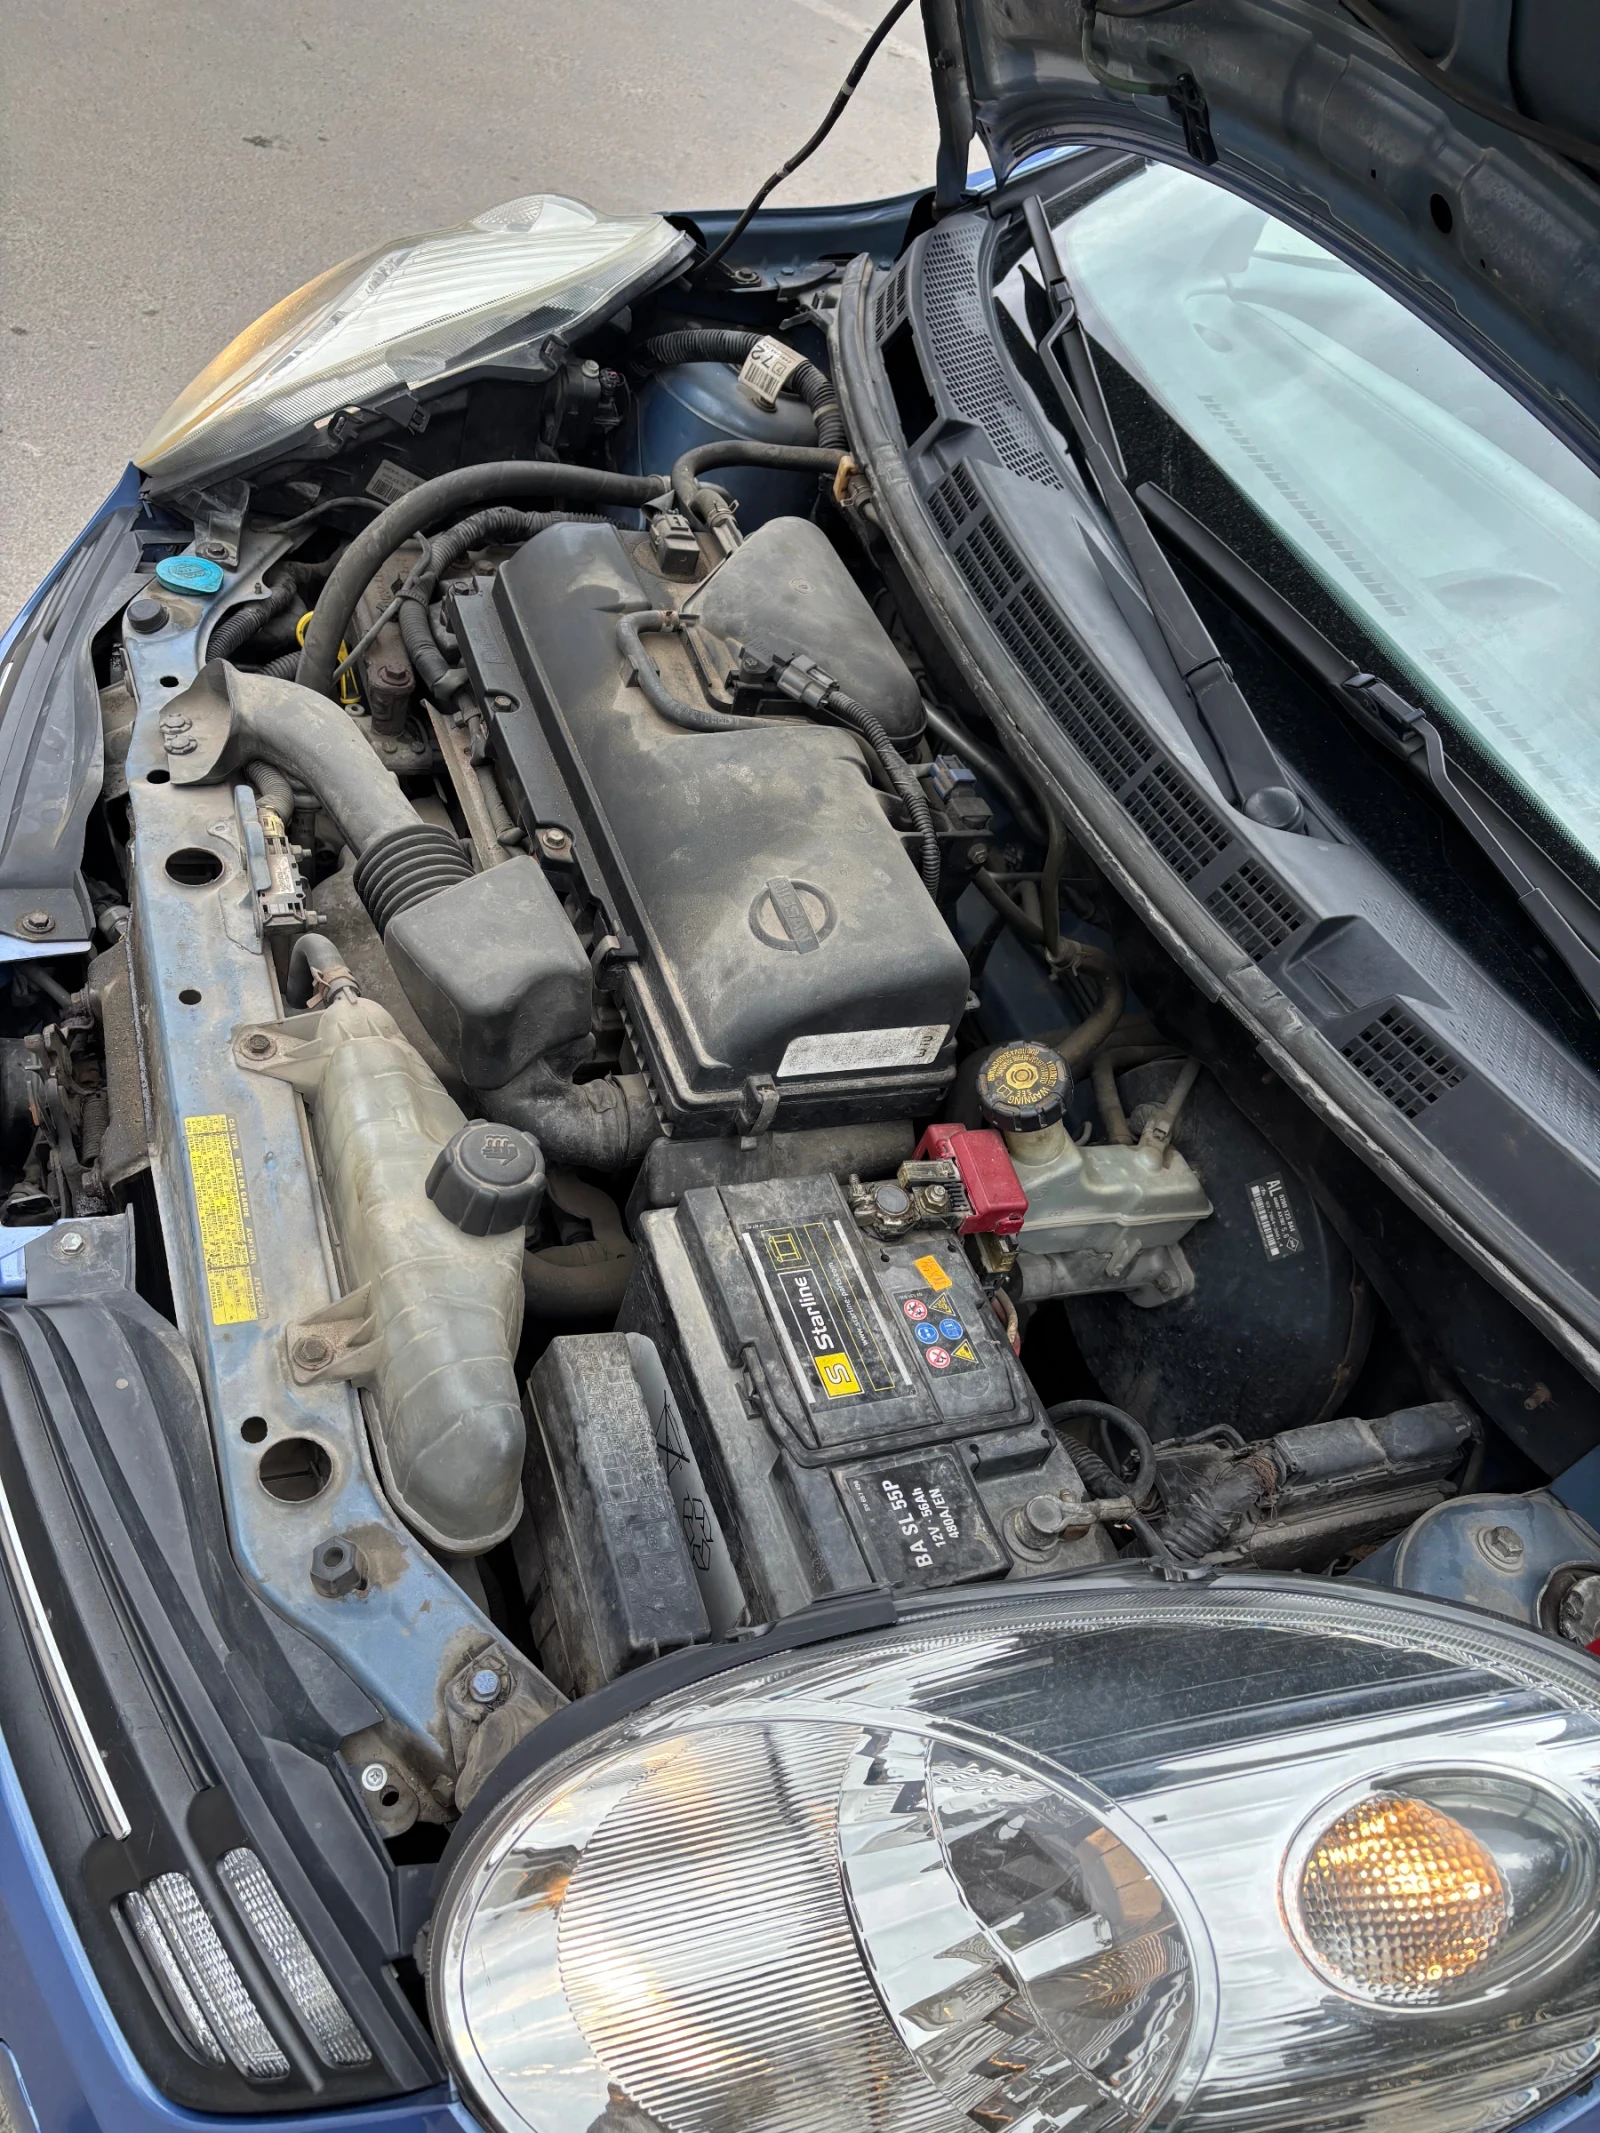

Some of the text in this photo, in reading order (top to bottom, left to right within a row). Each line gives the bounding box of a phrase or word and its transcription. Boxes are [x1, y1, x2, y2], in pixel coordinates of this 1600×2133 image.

[751, 344, 774, 369] 72
[773, 879, 812, 942] NISSAN
[1007, 1086, 1051, 1105] WARNING
[1015, 1089, 1031, 1097] SEE
[235, 1158, 244, 1177] MISE
[238, 1179, 246, 1189] EN
[1266, 1180, 1282, 1197] AL
[240, 1191, 250, 1218] GARDE
[794, 1276, 834, 1350] Starline
[828, 1262, 868, 1346] www.starline-parts.com
[882, 1480, 933, 1567] BA SL 55P
[912, 1487, 946, 1548] 12V 56Ah
[929, 1488, 960, 1538] 480A/EN
